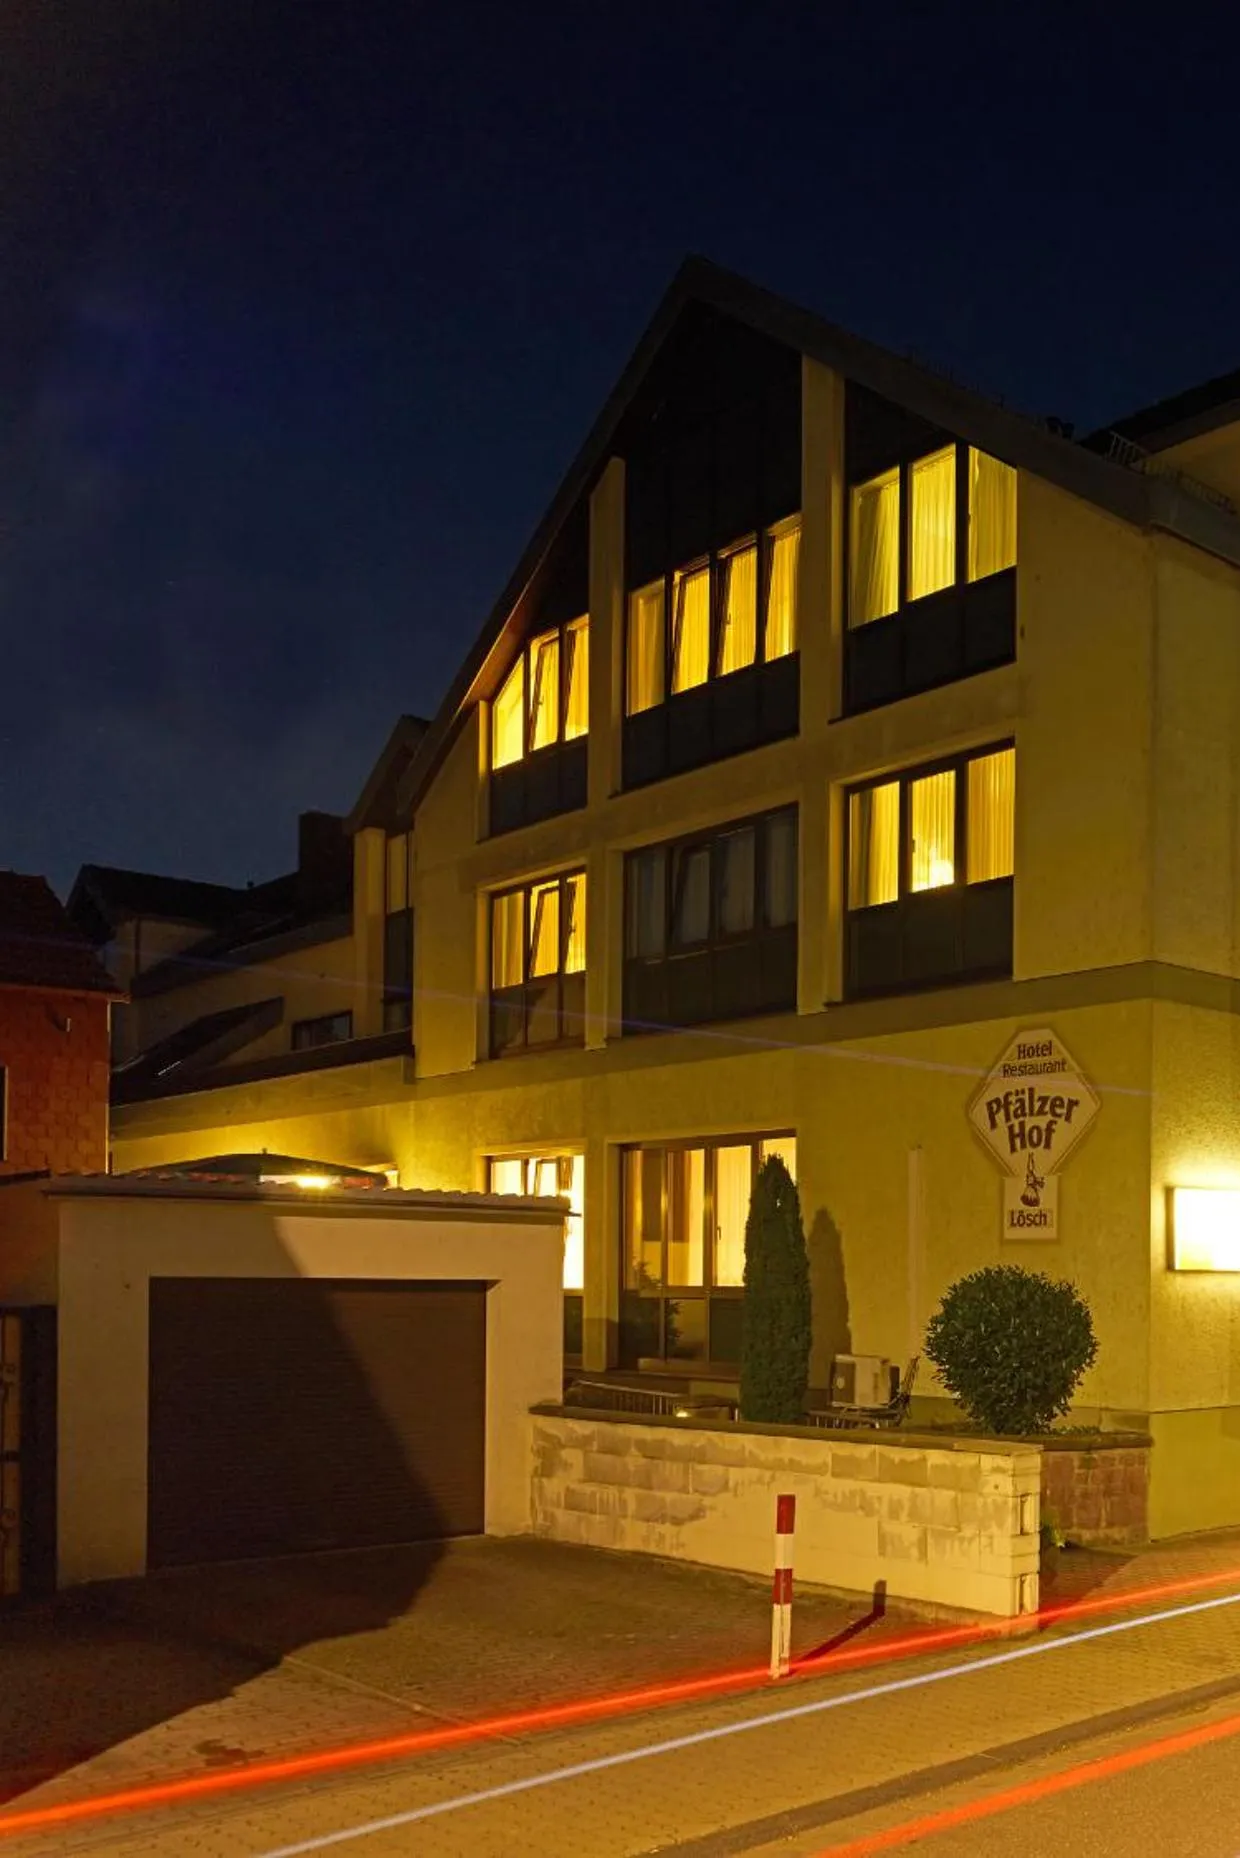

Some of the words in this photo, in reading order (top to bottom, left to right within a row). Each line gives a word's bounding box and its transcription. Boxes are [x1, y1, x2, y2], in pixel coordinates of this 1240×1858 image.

[1017, 1040, 1053, 1060] Hotel
[1002, 1059, 1068, 1078] Restaurant
[985, 1087, 1081, 1130] Pfälzer
[1007, 1119, 1058, 1154] Hof
[1009, 1209, 1048, 1228] Lösch
